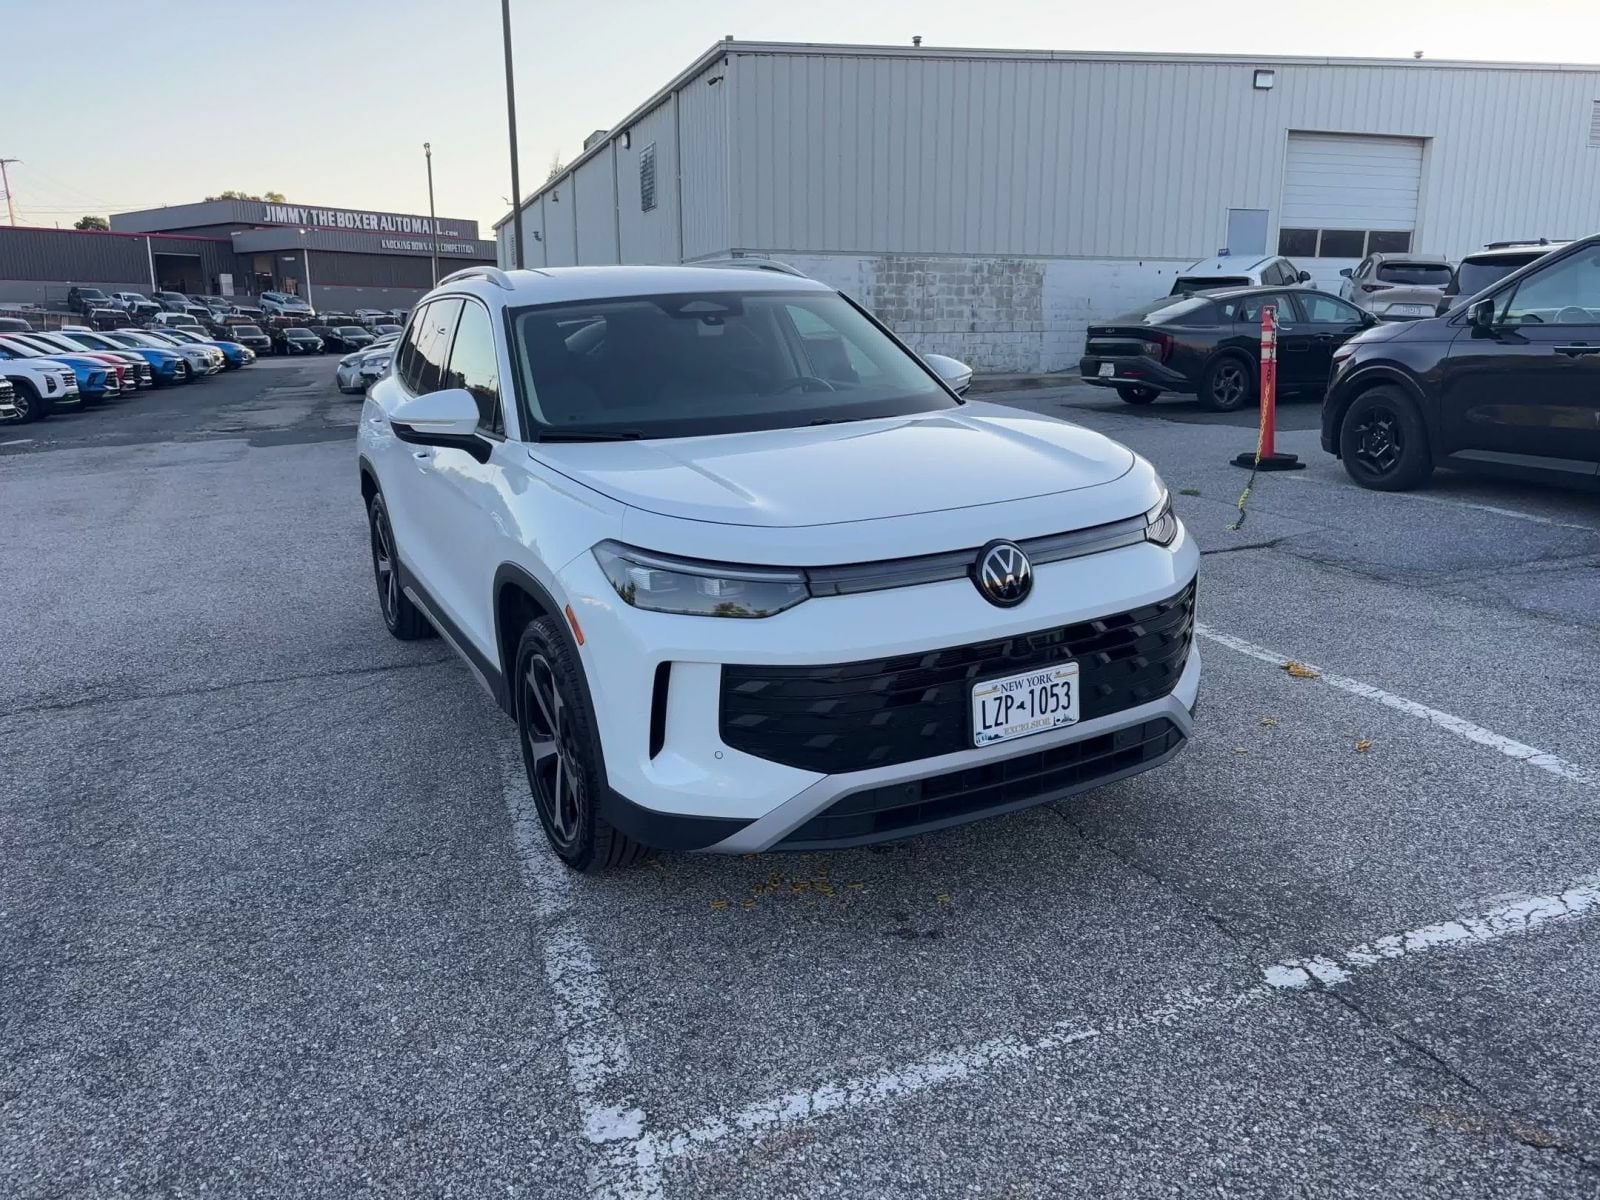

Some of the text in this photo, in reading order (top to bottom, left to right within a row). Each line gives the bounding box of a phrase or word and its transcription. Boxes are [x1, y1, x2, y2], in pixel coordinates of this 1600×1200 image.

[264, 206, 308, 224] JIMMY
[310, 210, 336, 226] THE
[336, 211, 378, 230] BOXER
[382, 240, 411, 250] KNOCKING
[412, 242, 427, 251] DOWN
[441, 244, 474, 253] COMPETITION
[1000, 673, 1054, 694] NEW YORK
[982, 682, 1071, 730] LZP 1053
